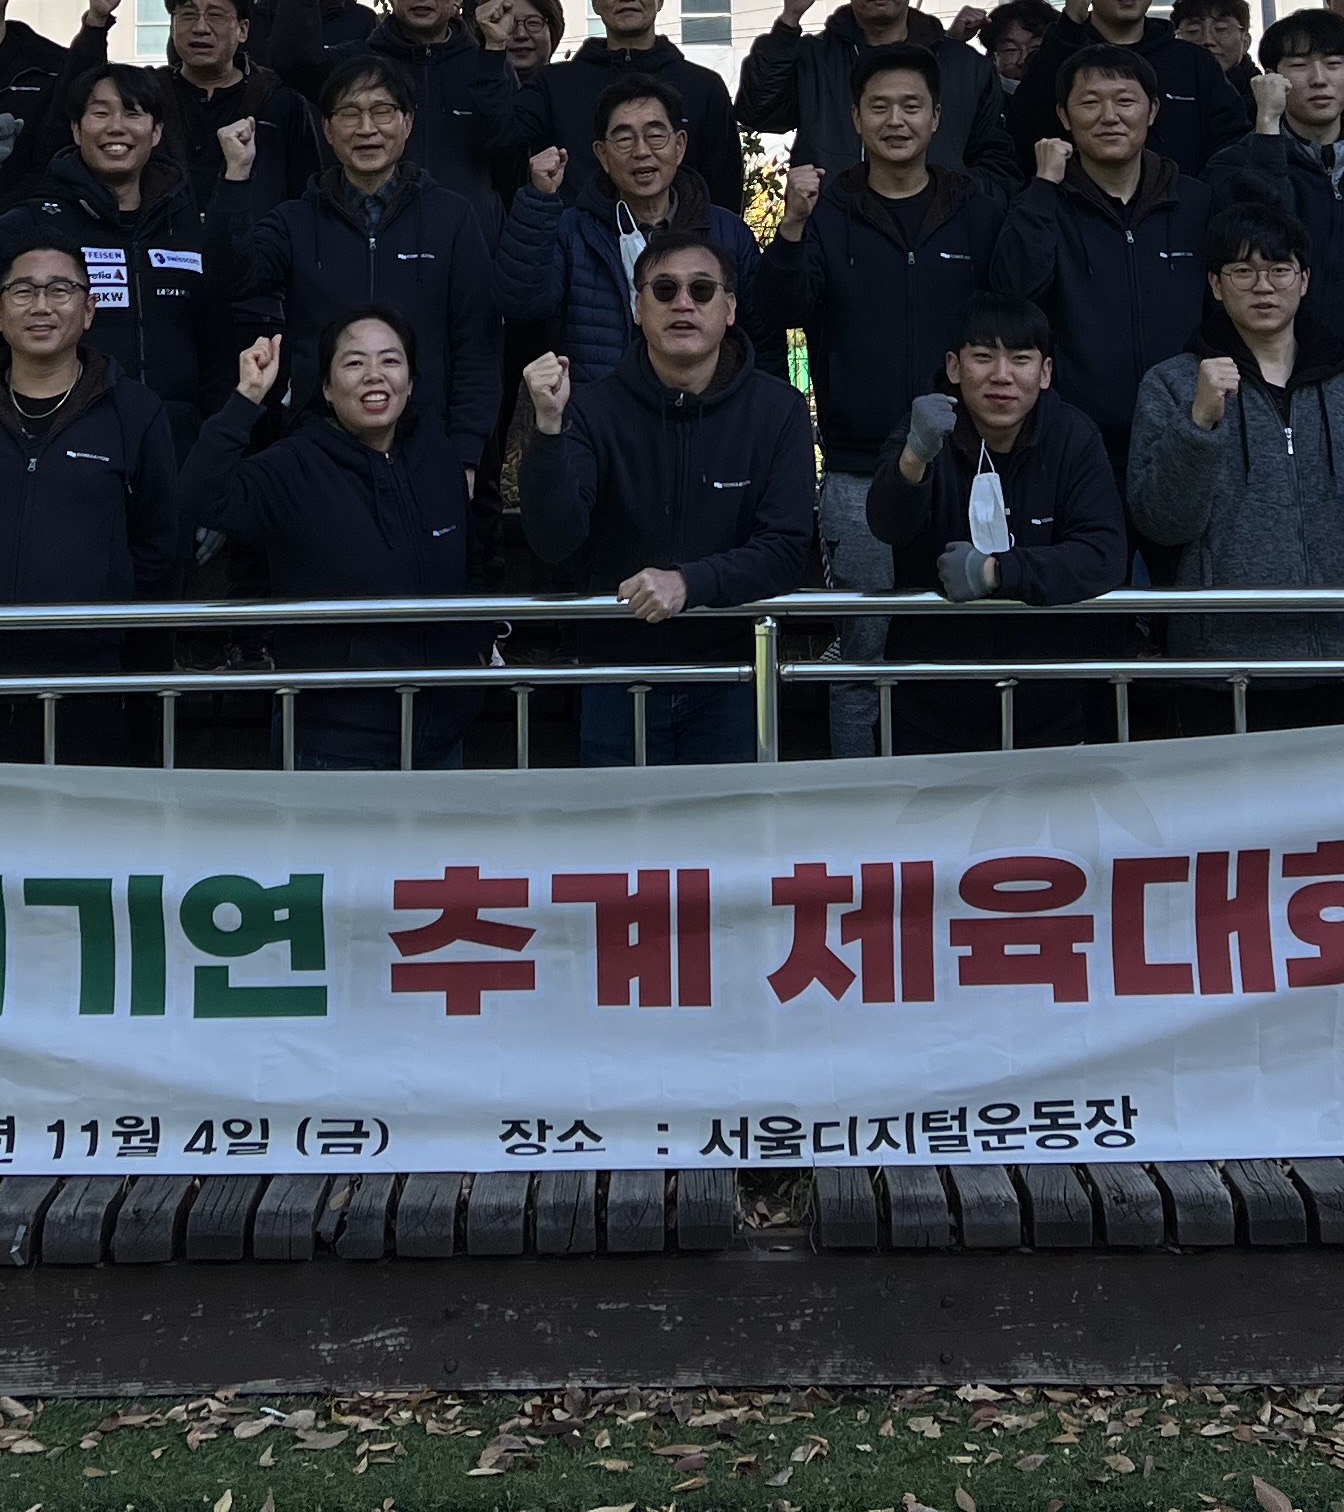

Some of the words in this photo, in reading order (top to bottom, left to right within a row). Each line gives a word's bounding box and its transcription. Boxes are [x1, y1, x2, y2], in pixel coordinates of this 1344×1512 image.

[388, 865, 712, 1016] 추계
[46, 1115, 161, 1161] 11월
[183, 1117, 271, 1156] 4일
[296, 1116, 391, 1157] (금)
[498, 1118, 607, 1156] 장소
[699, 1094, 1138, 1161] 서울디지털운동장
